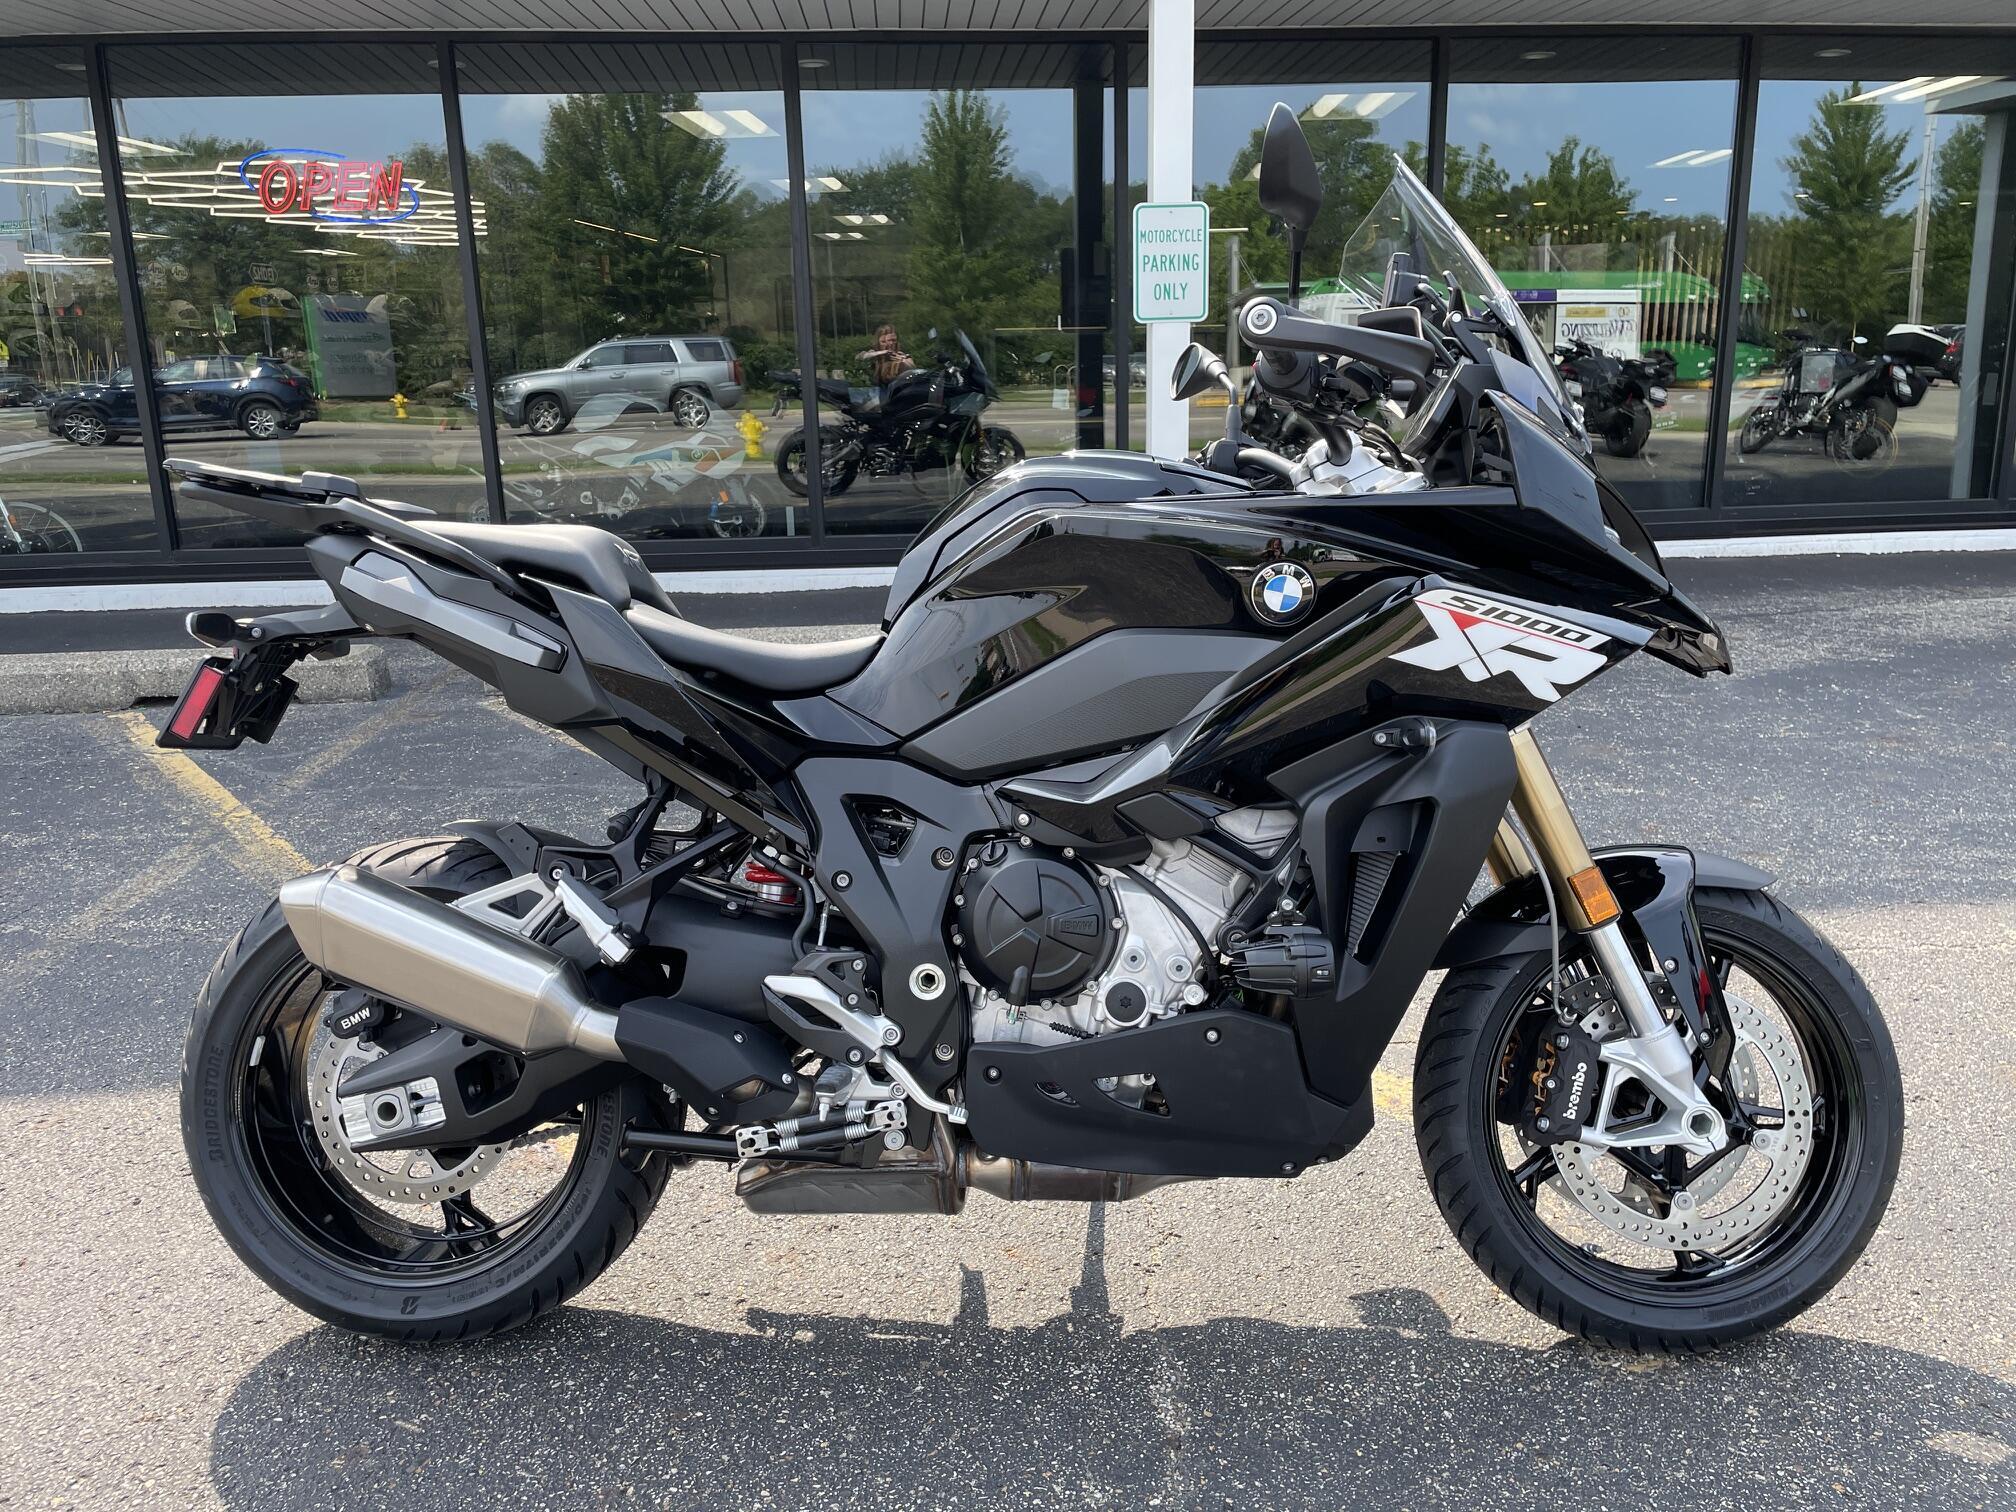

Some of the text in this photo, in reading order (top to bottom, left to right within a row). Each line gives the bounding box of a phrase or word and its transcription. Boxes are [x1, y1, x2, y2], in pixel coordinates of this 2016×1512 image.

[259, 159, 403, 214] OPEN
[1140, 229, 1203, 244] MOTORCYCLE
[252, 265, 276, 283] SHOEI
[1142, 253, 1200, 272] PARKING
[1153, 282, 1188, 301] ONLY
[1262, 564, 1312, 589] BMW
[1441, 596, 1592, 643] S1000
[1387, 600, 1608, 703] XR
[340, 1007, 371, 1030] BMW
[1562, 1061, 1588, 1120] brembo
[204, 1045, 225, 1162] BRIDGESTONE
